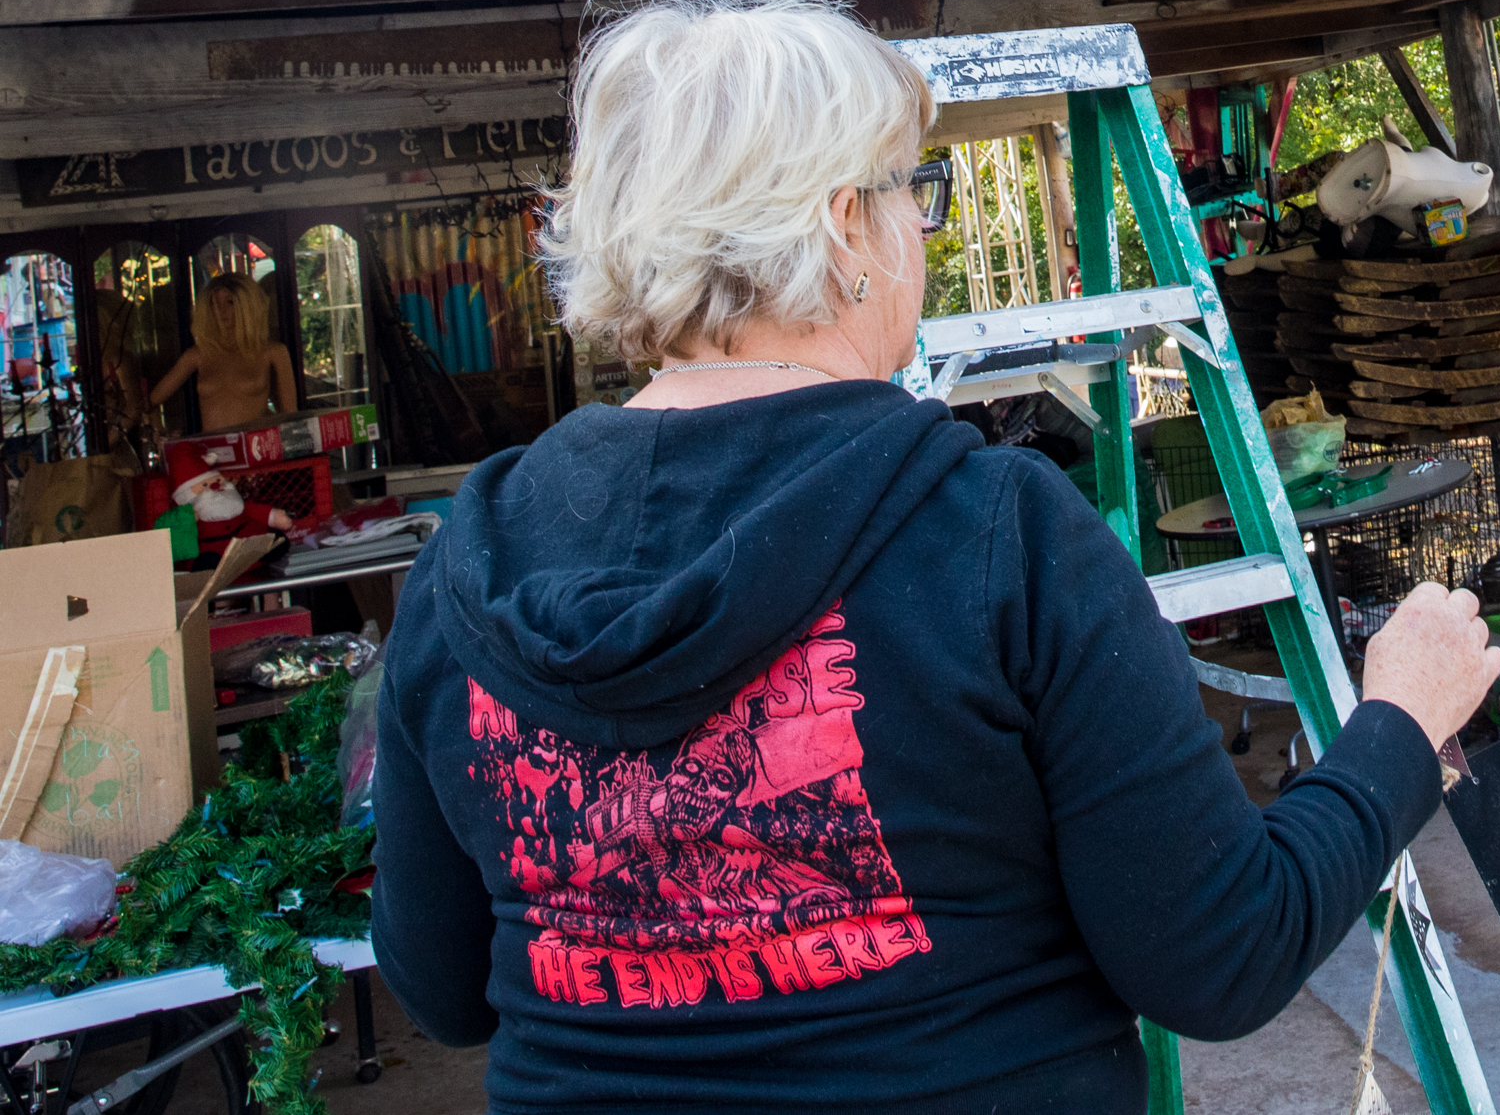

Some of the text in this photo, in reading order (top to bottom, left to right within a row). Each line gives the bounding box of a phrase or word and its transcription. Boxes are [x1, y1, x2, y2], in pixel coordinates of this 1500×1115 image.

[984, 58, 1048, 77] HUSKY
[595, 370, 627, 383] ARTIST
[528, 912, 932, 1009] THE END IS HERE!
